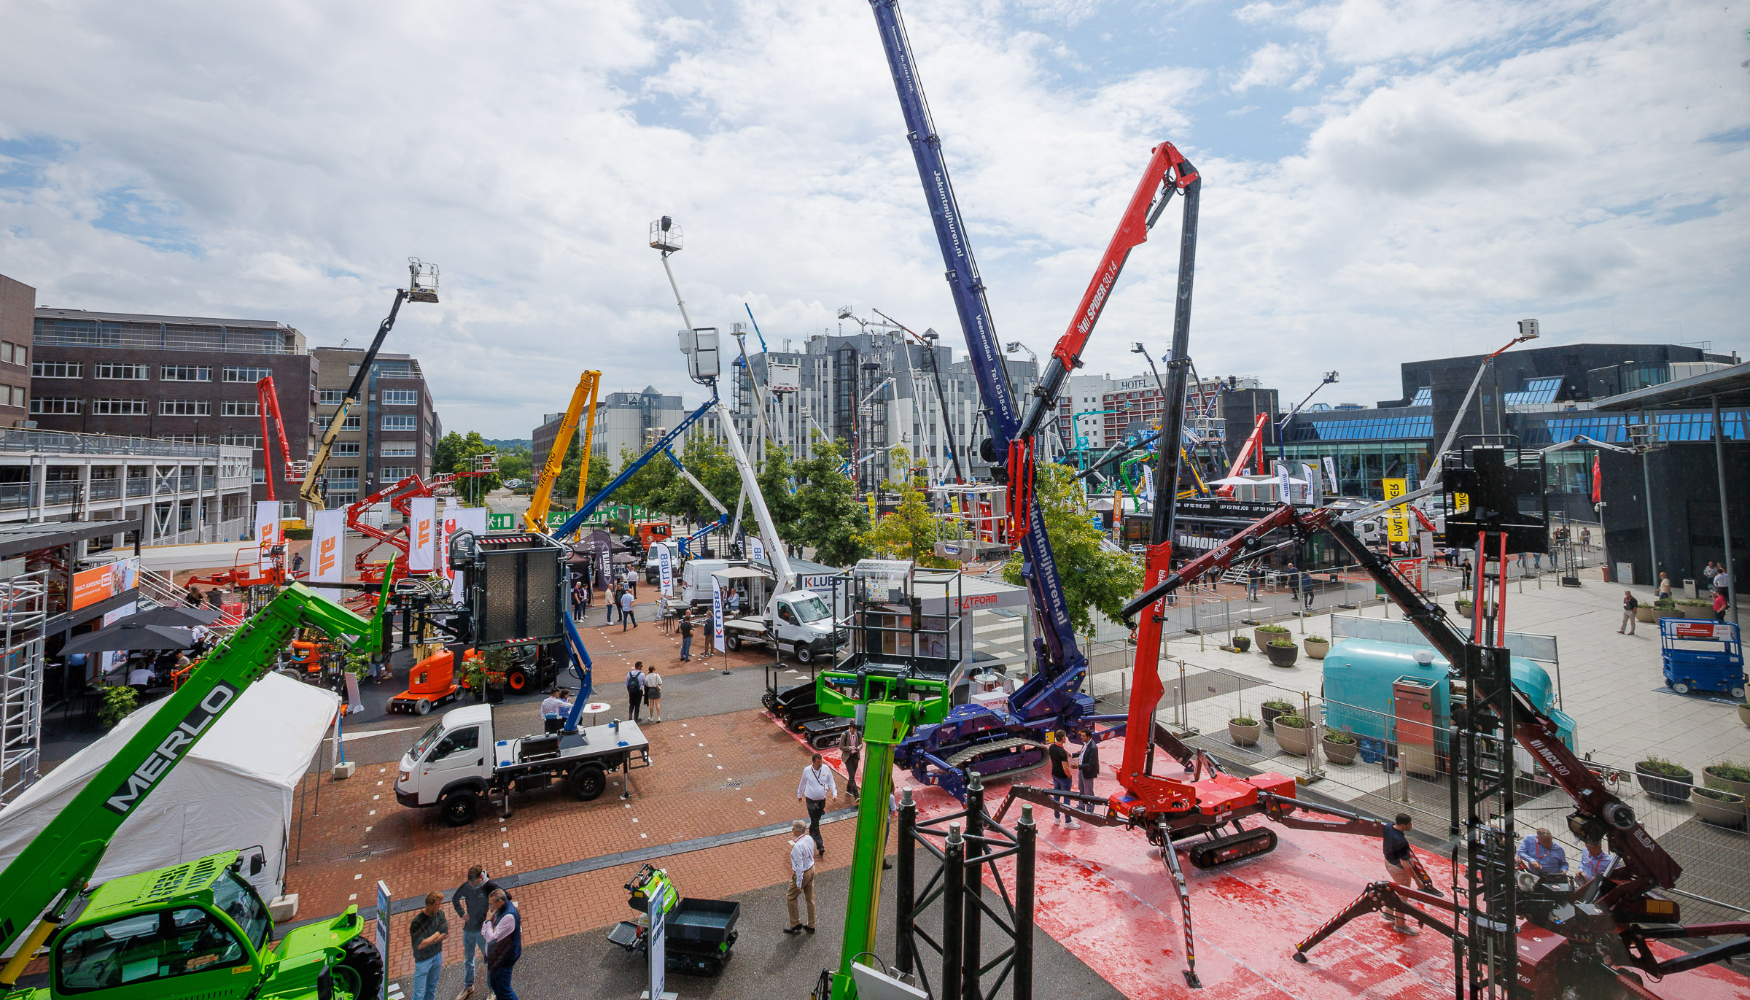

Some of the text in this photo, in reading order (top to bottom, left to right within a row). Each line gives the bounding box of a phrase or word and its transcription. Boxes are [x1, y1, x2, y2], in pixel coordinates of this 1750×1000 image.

[1087, 283, 1107, 321] SPIDER
[975, 314, 993, 362] Veenendaal
[990, 367, 999, 383] Tel.
[1121, 379, 1149, 390] HOTEL
[539, 451, 556, 489] SIESLING
[1180, 535, 1227, 549] DINOlif
[1030, 506, 1067, 626] kuntmijhuren.nl
[106, 684, 236, 814] MERLO
[1541, 748, 1571, 776] MCX 90
[1520, 975, 1531, 984] 90
